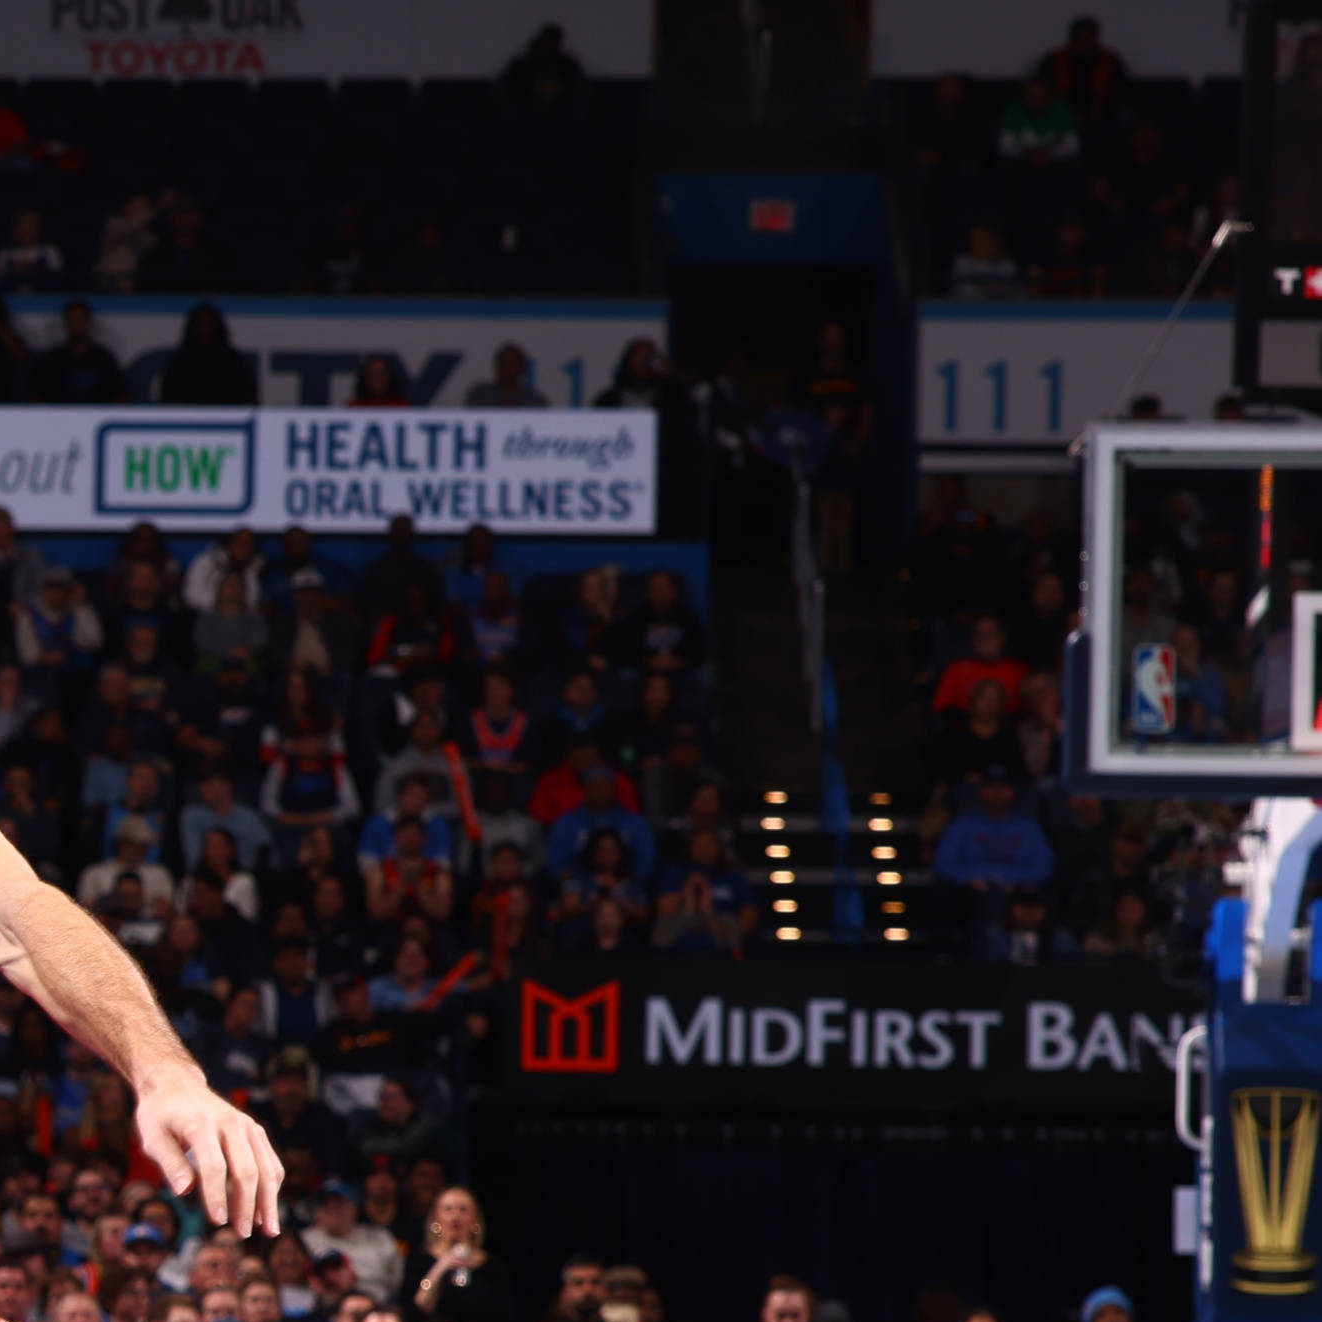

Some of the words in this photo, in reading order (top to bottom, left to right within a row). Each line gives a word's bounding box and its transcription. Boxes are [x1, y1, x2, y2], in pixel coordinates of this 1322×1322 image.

[87, 38, 265, 75] TOYOTA
[937, 360, 1065, 433] 111
[125, 444, 225, 492] HOW
[285, 421, 486, 470] HEALTH
[503, 427, 635, 468] through
[285, 479, 386, 520] ORAL
[408, 480, 633, 521] WELLNESS
